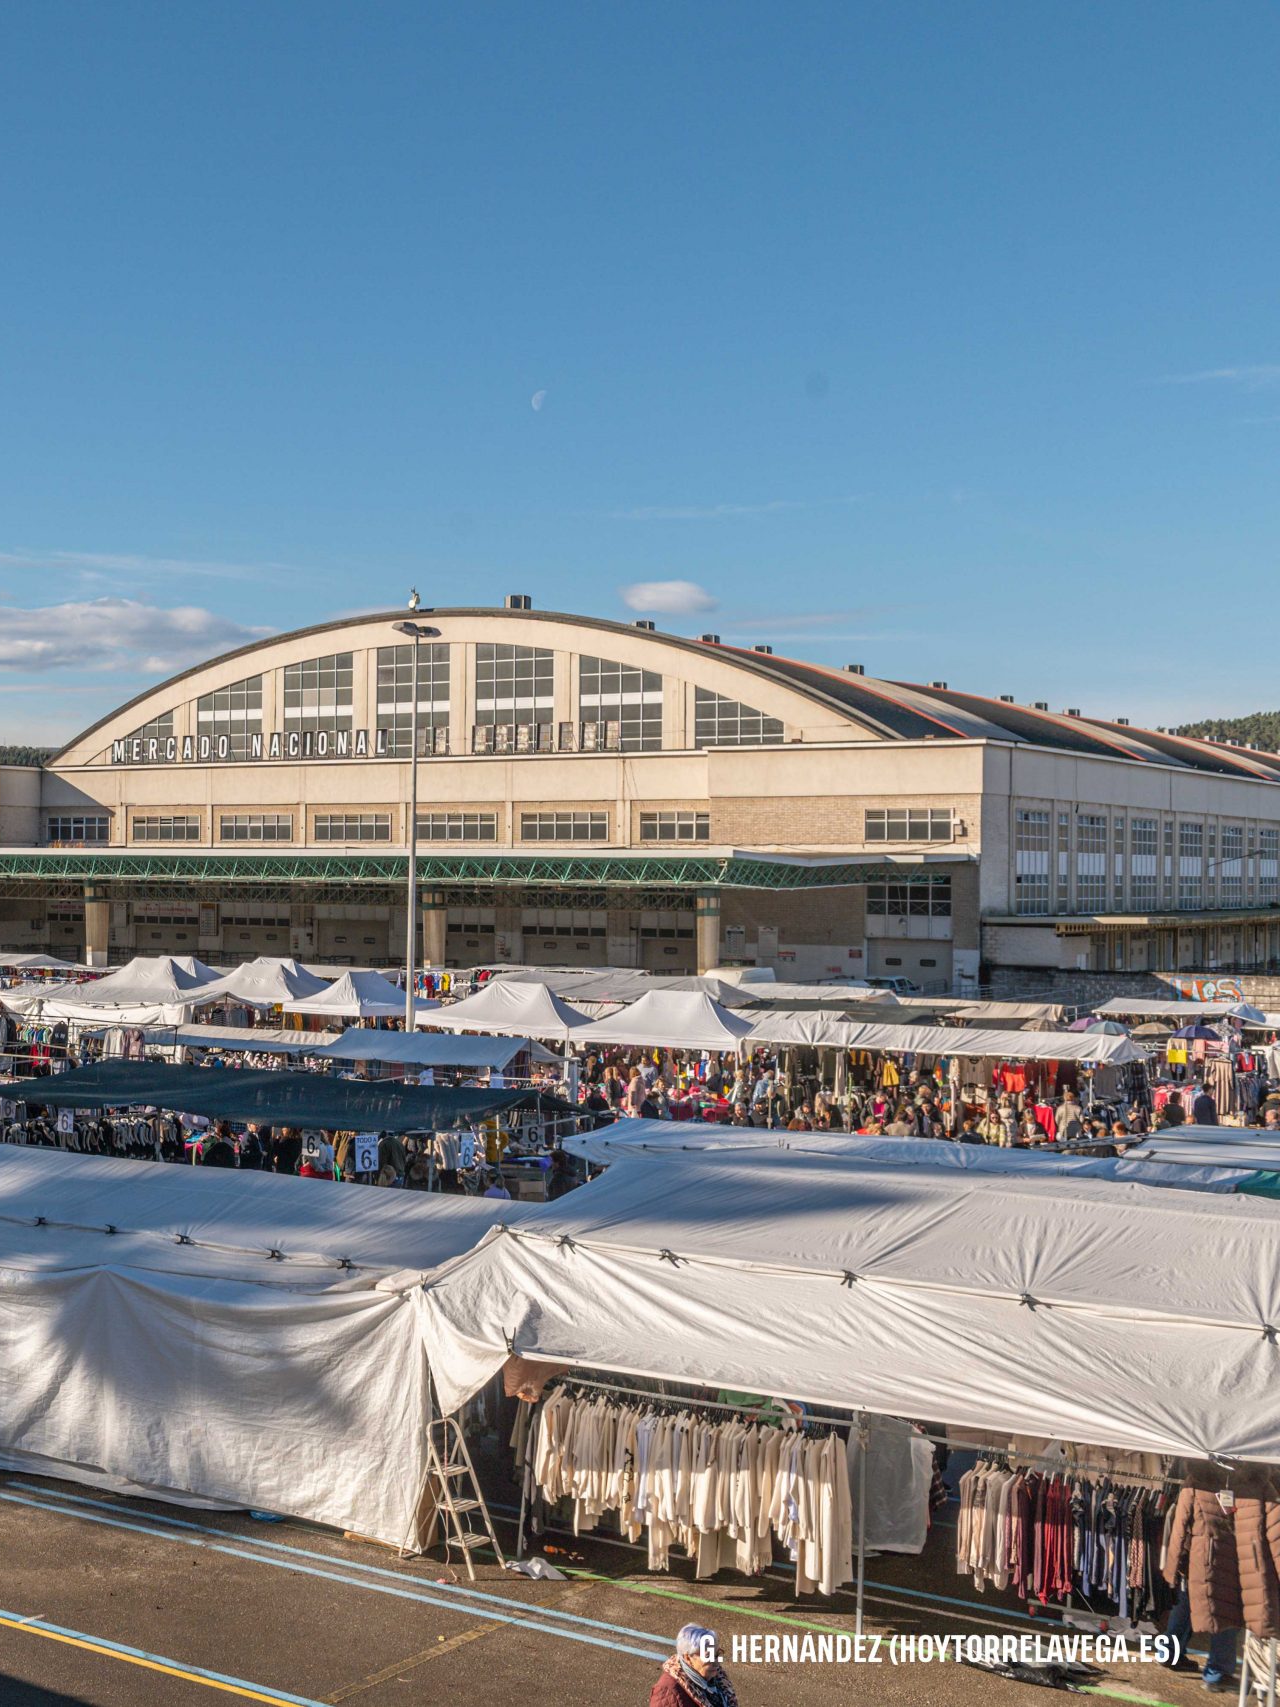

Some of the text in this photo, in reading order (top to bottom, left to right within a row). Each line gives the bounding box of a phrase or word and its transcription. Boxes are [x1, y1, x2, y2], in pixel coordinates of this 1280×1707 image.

[113, 735, 228, 762] MERCADO
[251, 730, 385, 757] NACIONAL
[356, 1136, 372, 1144] TODO
